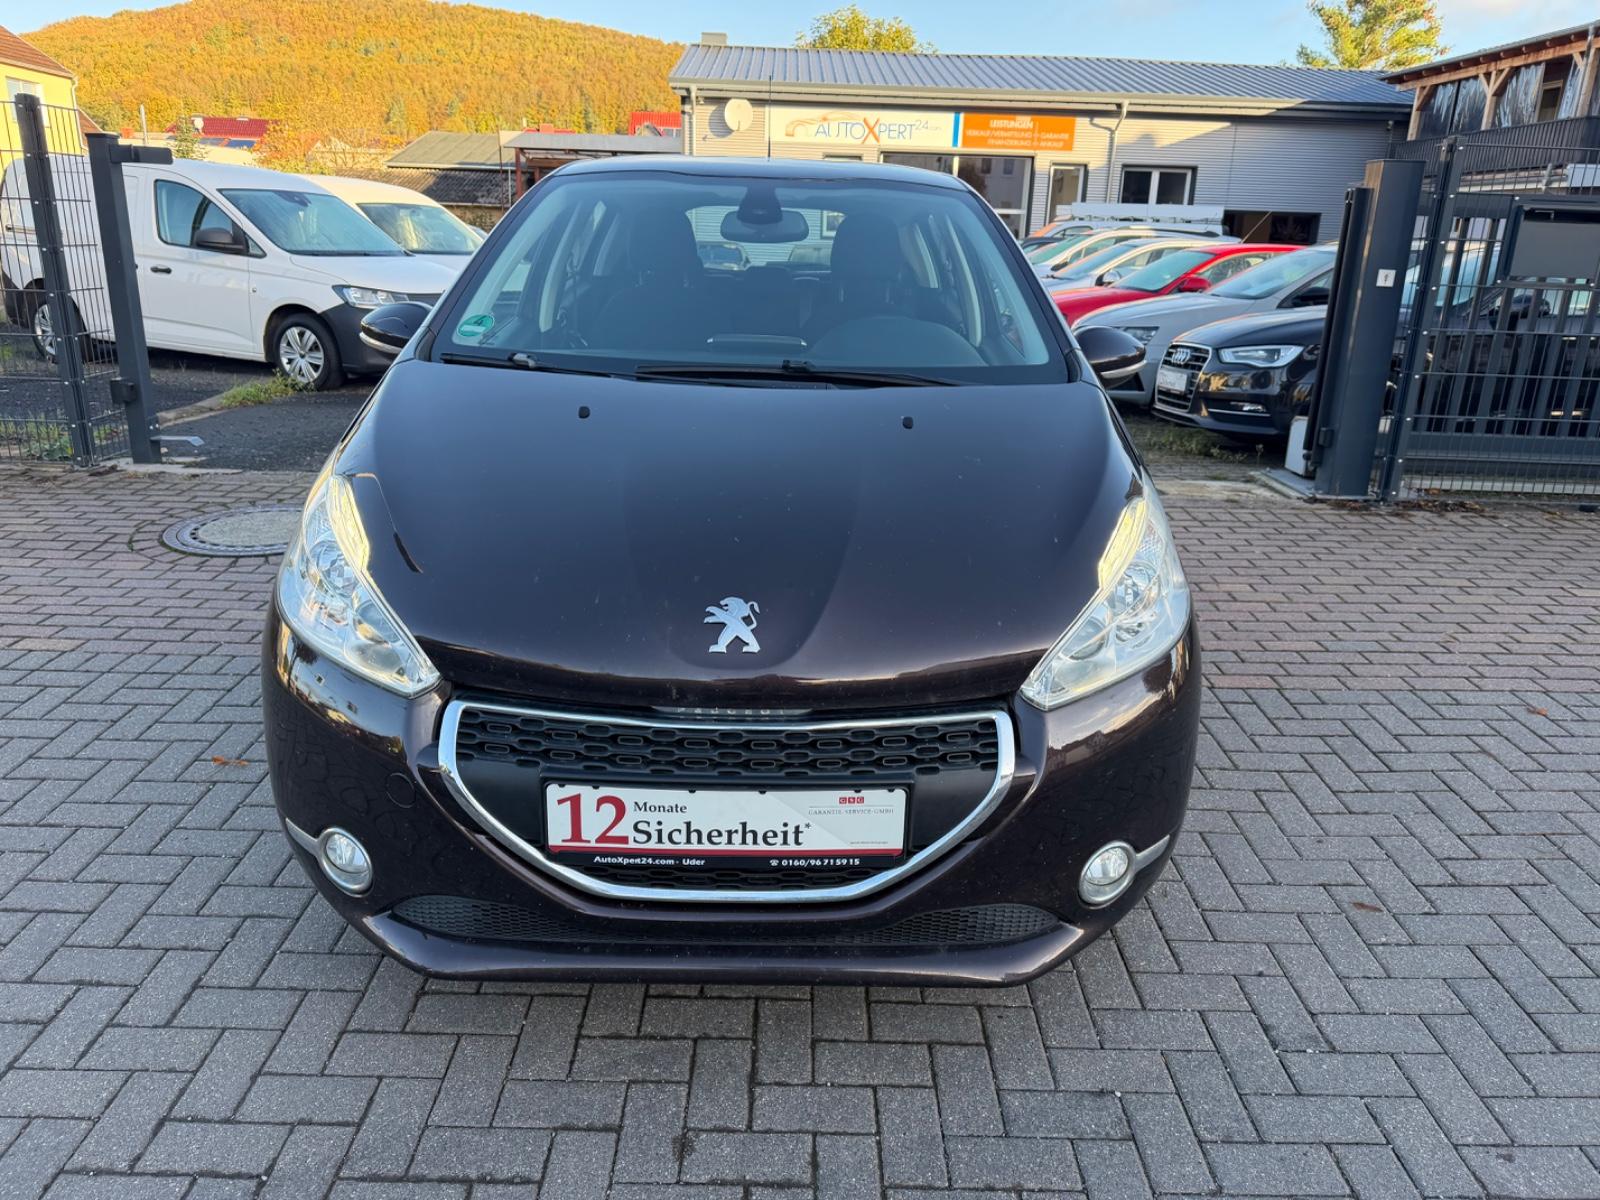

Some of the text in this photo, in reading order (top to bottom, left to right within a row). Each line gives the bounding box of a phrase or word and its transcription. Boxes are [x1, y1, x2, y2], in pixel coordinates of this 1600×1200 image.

[989, 119, 1034, 129] LEISTUNGEN
[633, 801, 687, 813] Monate
[557, 793, 629, 845] 12
[593, 856, 674, 865] AutoXpert24.com
